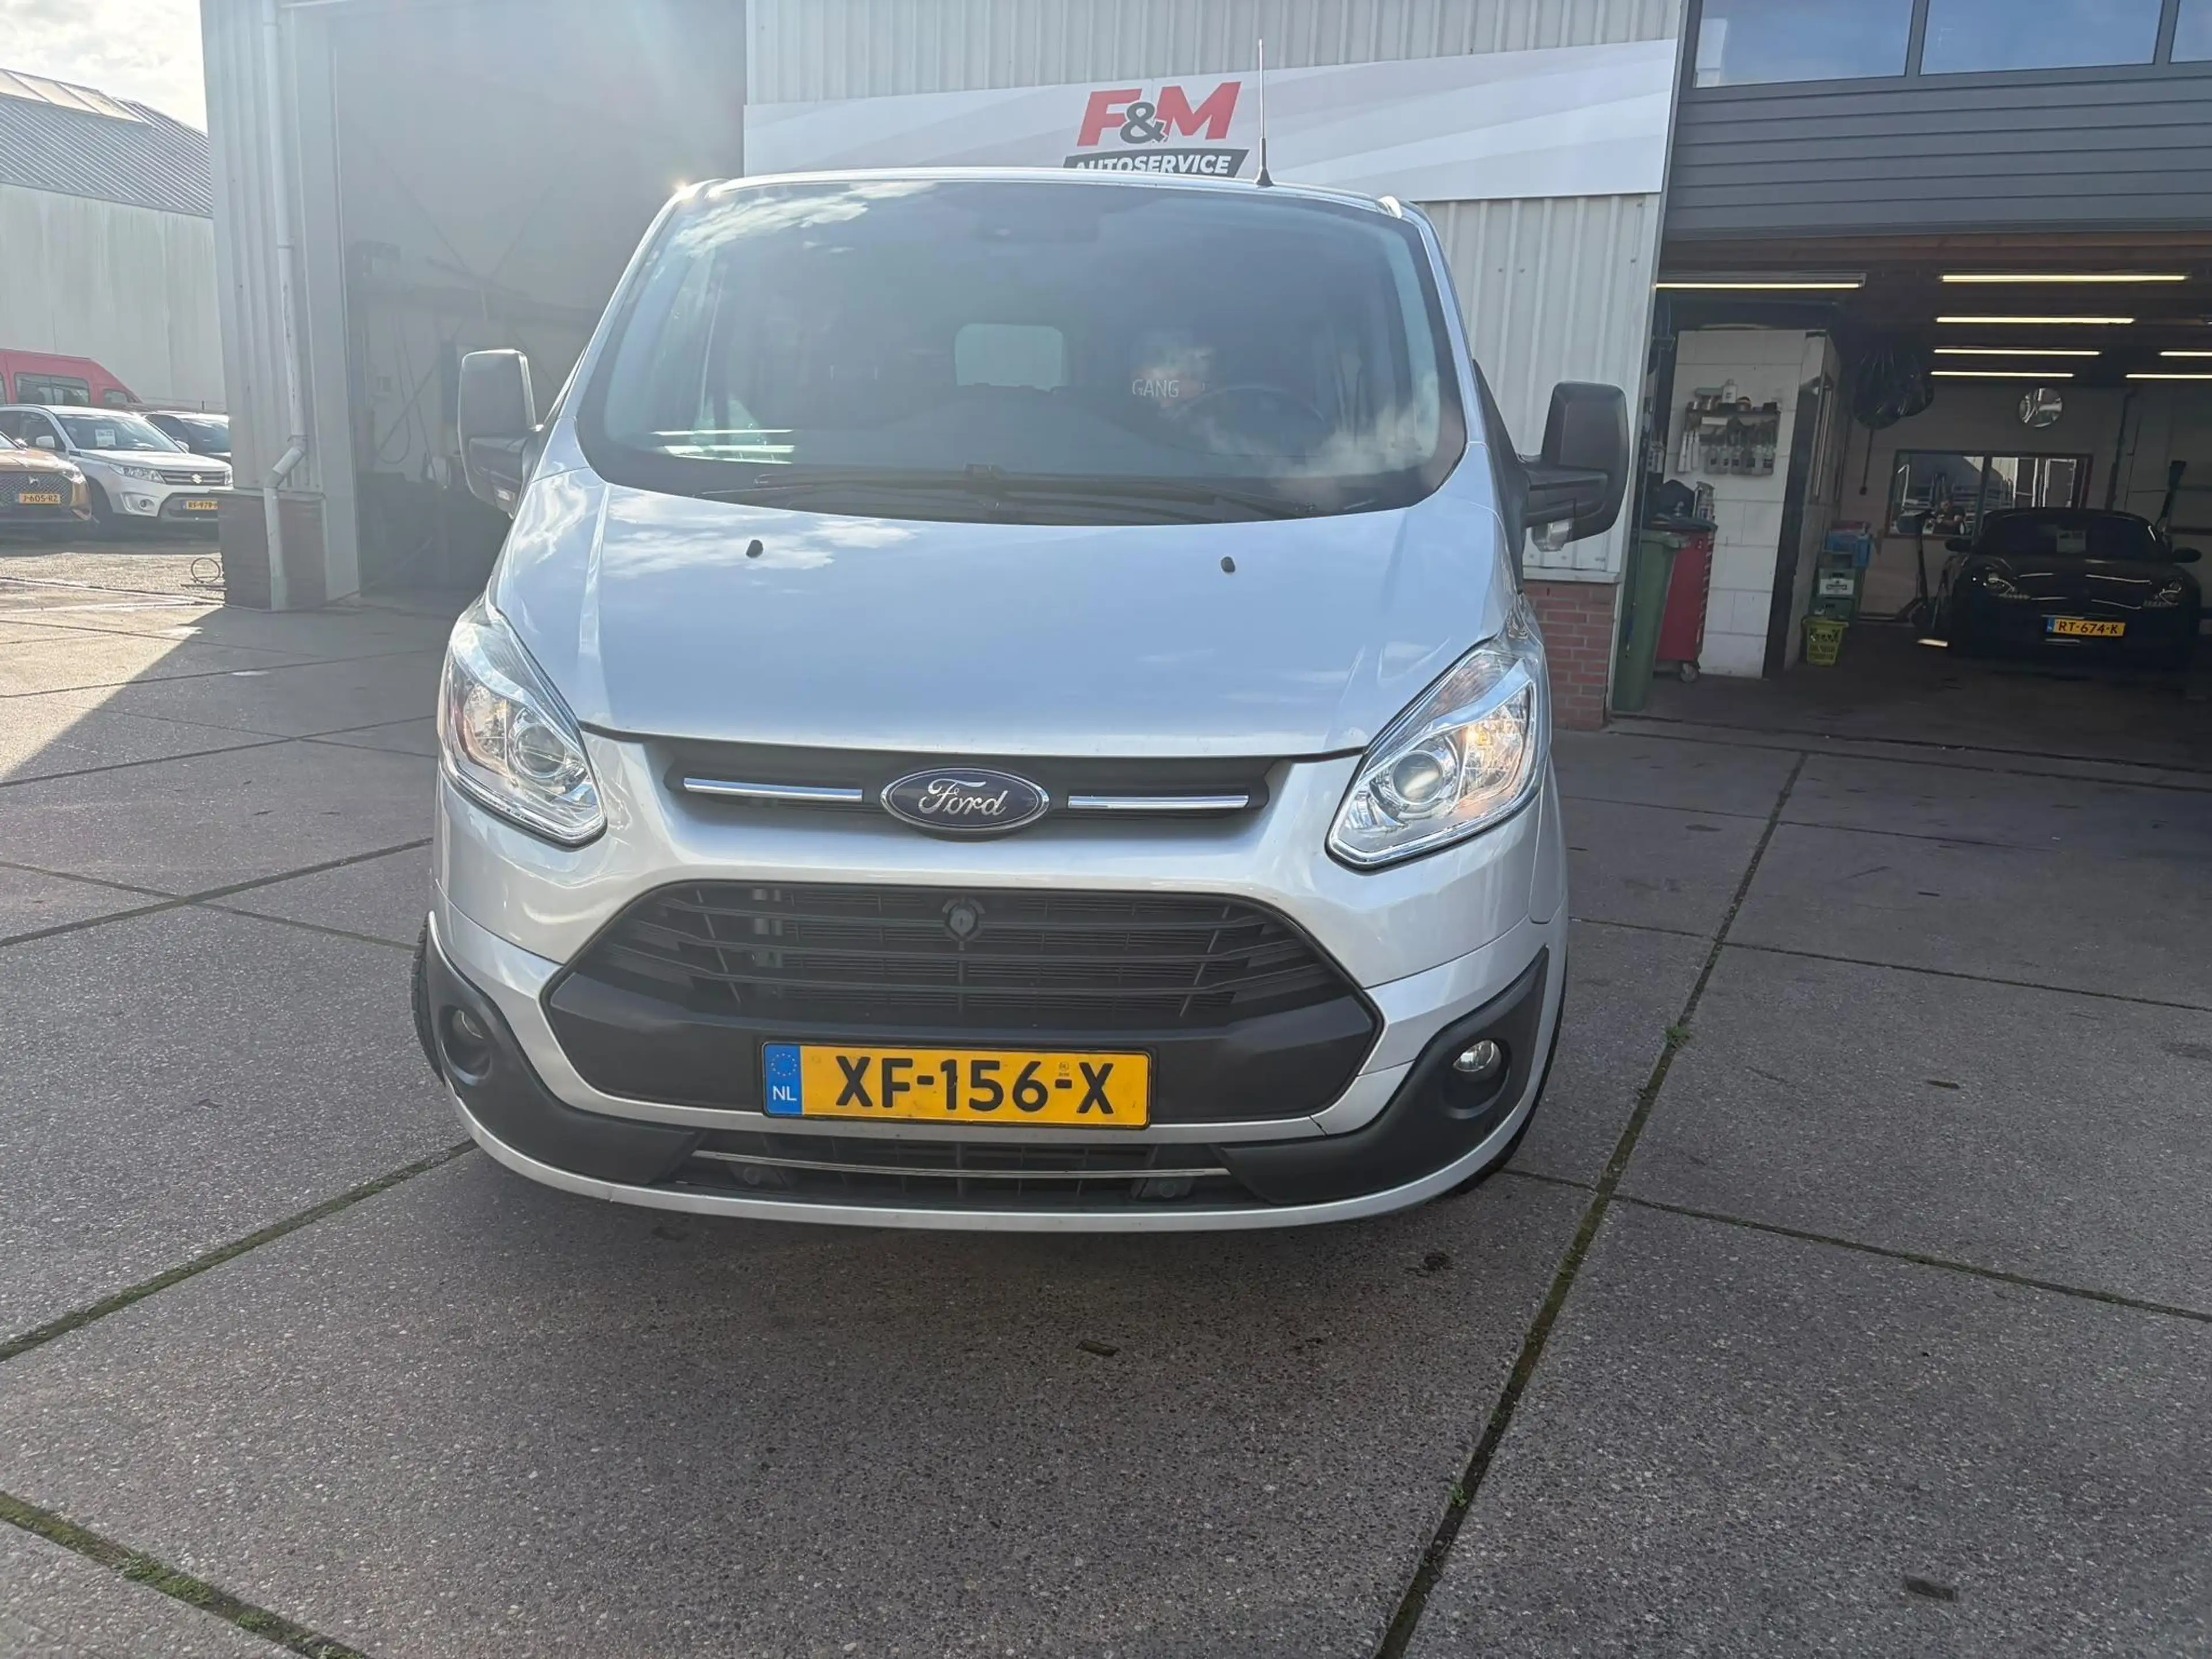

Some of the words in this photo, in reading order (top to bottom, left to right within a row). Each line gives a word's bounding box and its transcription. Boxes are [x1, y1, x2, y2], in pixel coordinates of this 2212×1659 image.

[1077, 81, 1241, 147] F&M
[2058, 621, 2118, 634] RT-674-K
[918, 778, 1009, 817] Ford
[773, 1085, 797, 1101] NL
[835, 1055, 1113, 1115] XF-156-X
